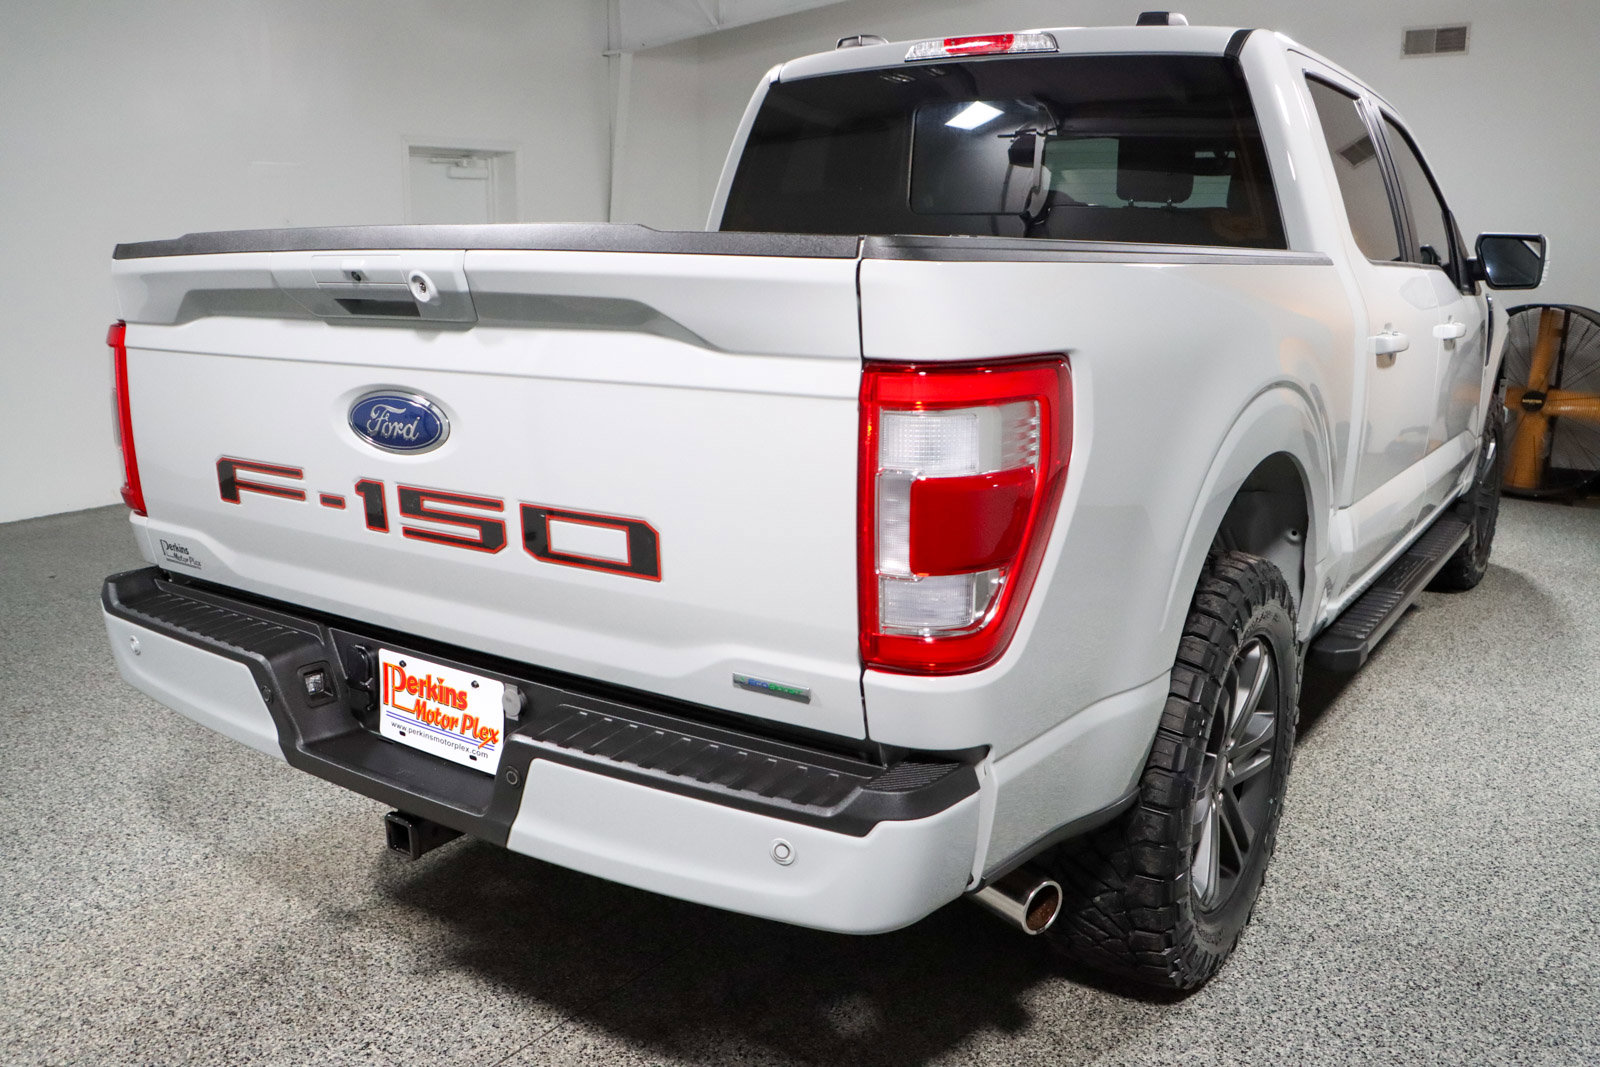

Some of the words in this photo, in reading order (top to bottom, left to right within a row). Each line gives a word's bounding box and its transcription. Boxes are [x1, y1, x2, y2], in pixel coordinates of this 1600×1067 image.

[366, 403, 422, 441] Ford
[216, 455, 662, 582] F-150
[382, 661, 468, 712] Perkins
[390, 720, 489, 760] www.perkinsmotorplex.com
[412, 698, 460, 732] Motor
[459, 712, 500, 750] Plex
